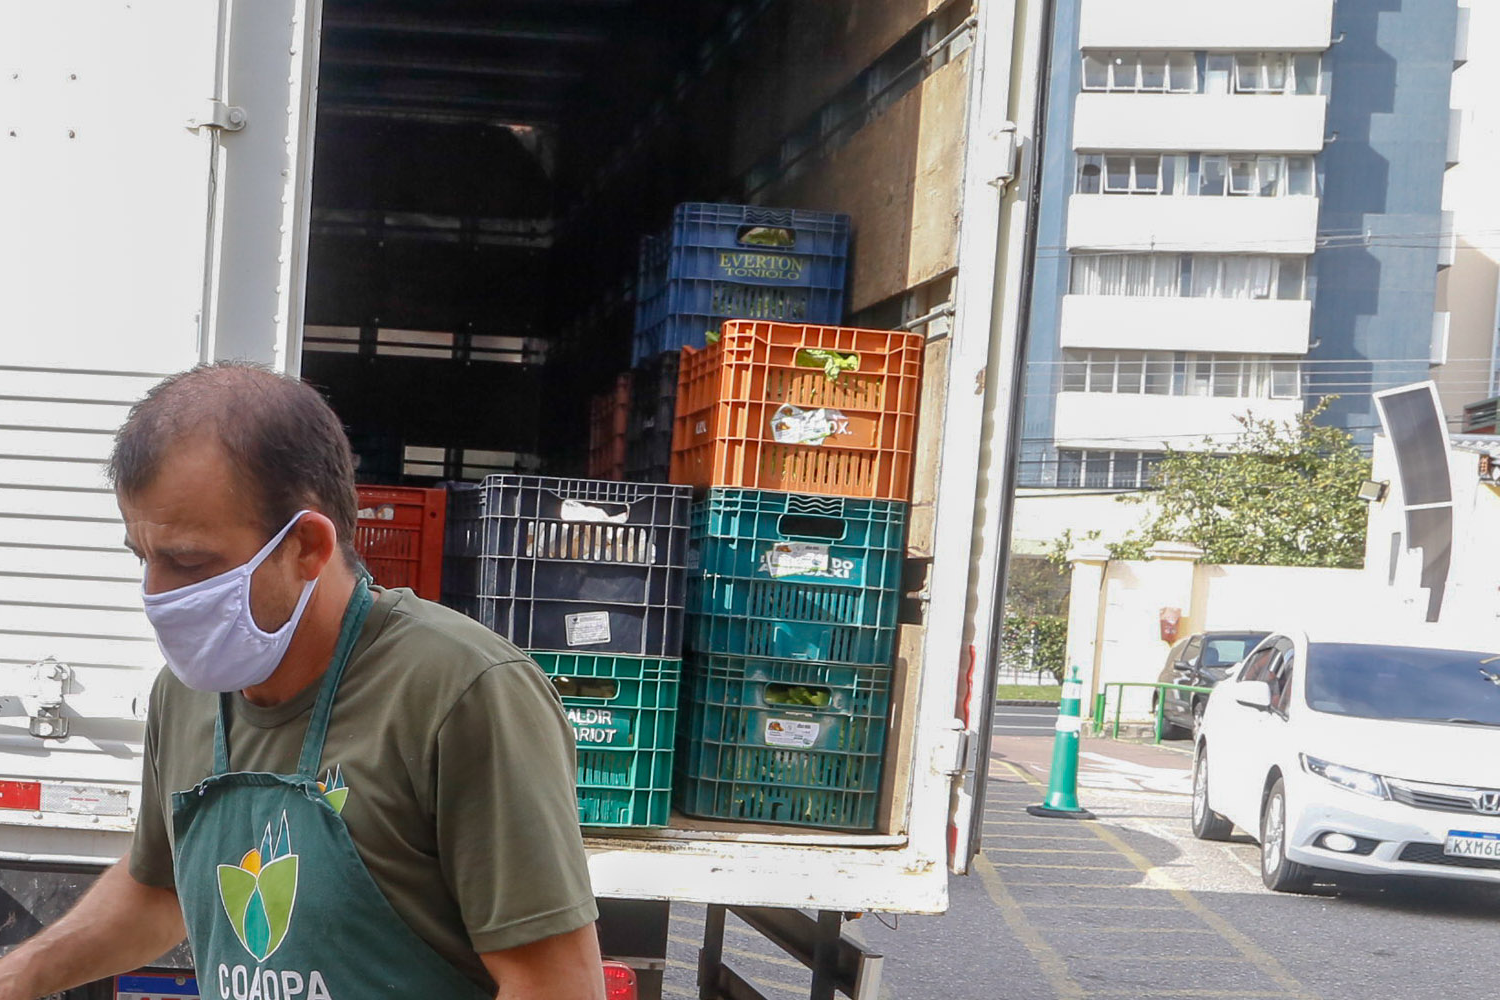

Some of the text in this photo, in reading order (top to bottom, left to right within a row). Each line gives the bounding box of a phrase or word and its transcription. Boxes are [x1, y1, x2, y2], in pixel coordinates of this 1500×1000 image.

[720, 254, 803, 271] EVERTON
[725, 268, 799, 280] TONIOLO
[831, 557, 854, 570] DO
[563, 708, 612, 725] ALDIR
